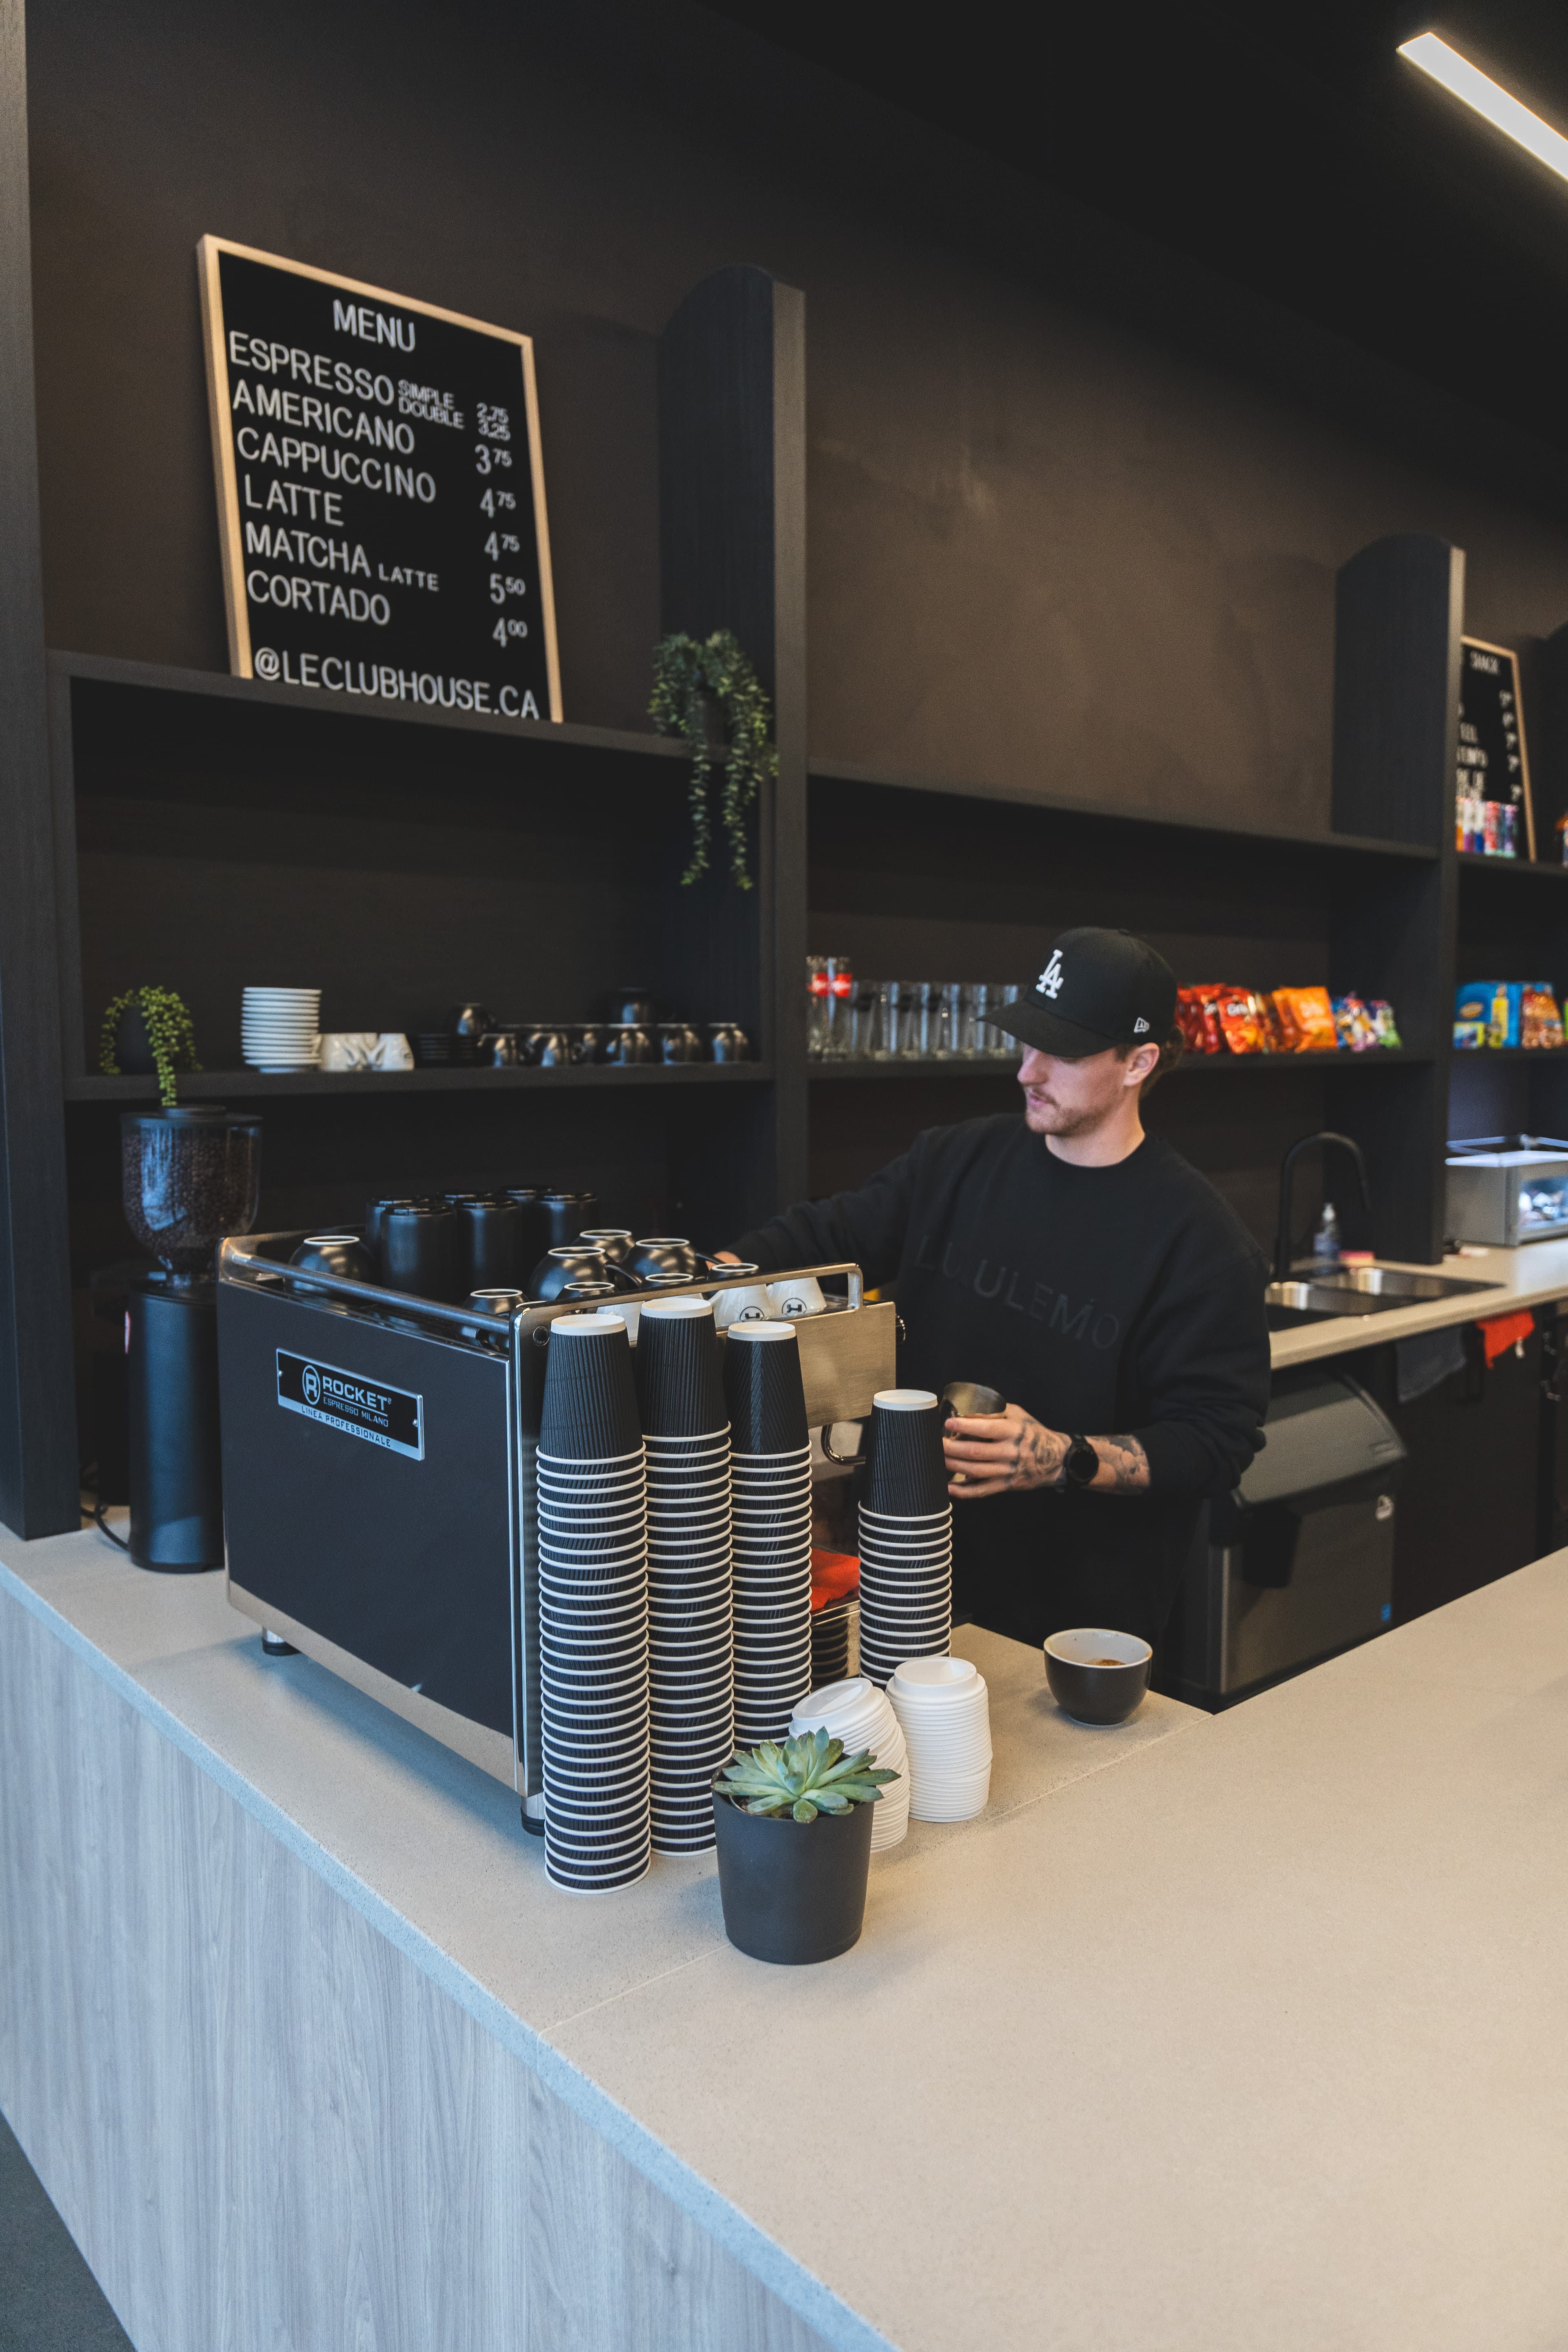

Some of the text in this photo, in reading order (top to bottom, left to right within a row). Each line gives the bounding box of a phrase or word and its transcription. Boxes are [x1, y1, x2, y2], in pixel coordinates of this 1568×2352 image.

[333, 299, 416, 352] MENU
[229, 330, 394, 406] ESPRESSO
[398, 379, 455, 410] SIMPLE
[233, 379, 414, 454] AMERICANO
[398, 396, 465, 430] DOUBLE
[237, 427, 437, 503] CAPPUCCINO
[245, 474, 344, 527] LATTE
[246, 521, 371, 578] MATCHA
[378, 563, 440, 592] LATTE
[247, 570, 390, 626] CORTADO
[254, 647, 539, 720] @LECLUBHOUSE.CA
[1036, 949, 1064, 999] LA
[301, 1405, 391, 1448] LINEA PROFESSIONALE
[323, 1396, 388, 1428] ESPRESSO MILANO
